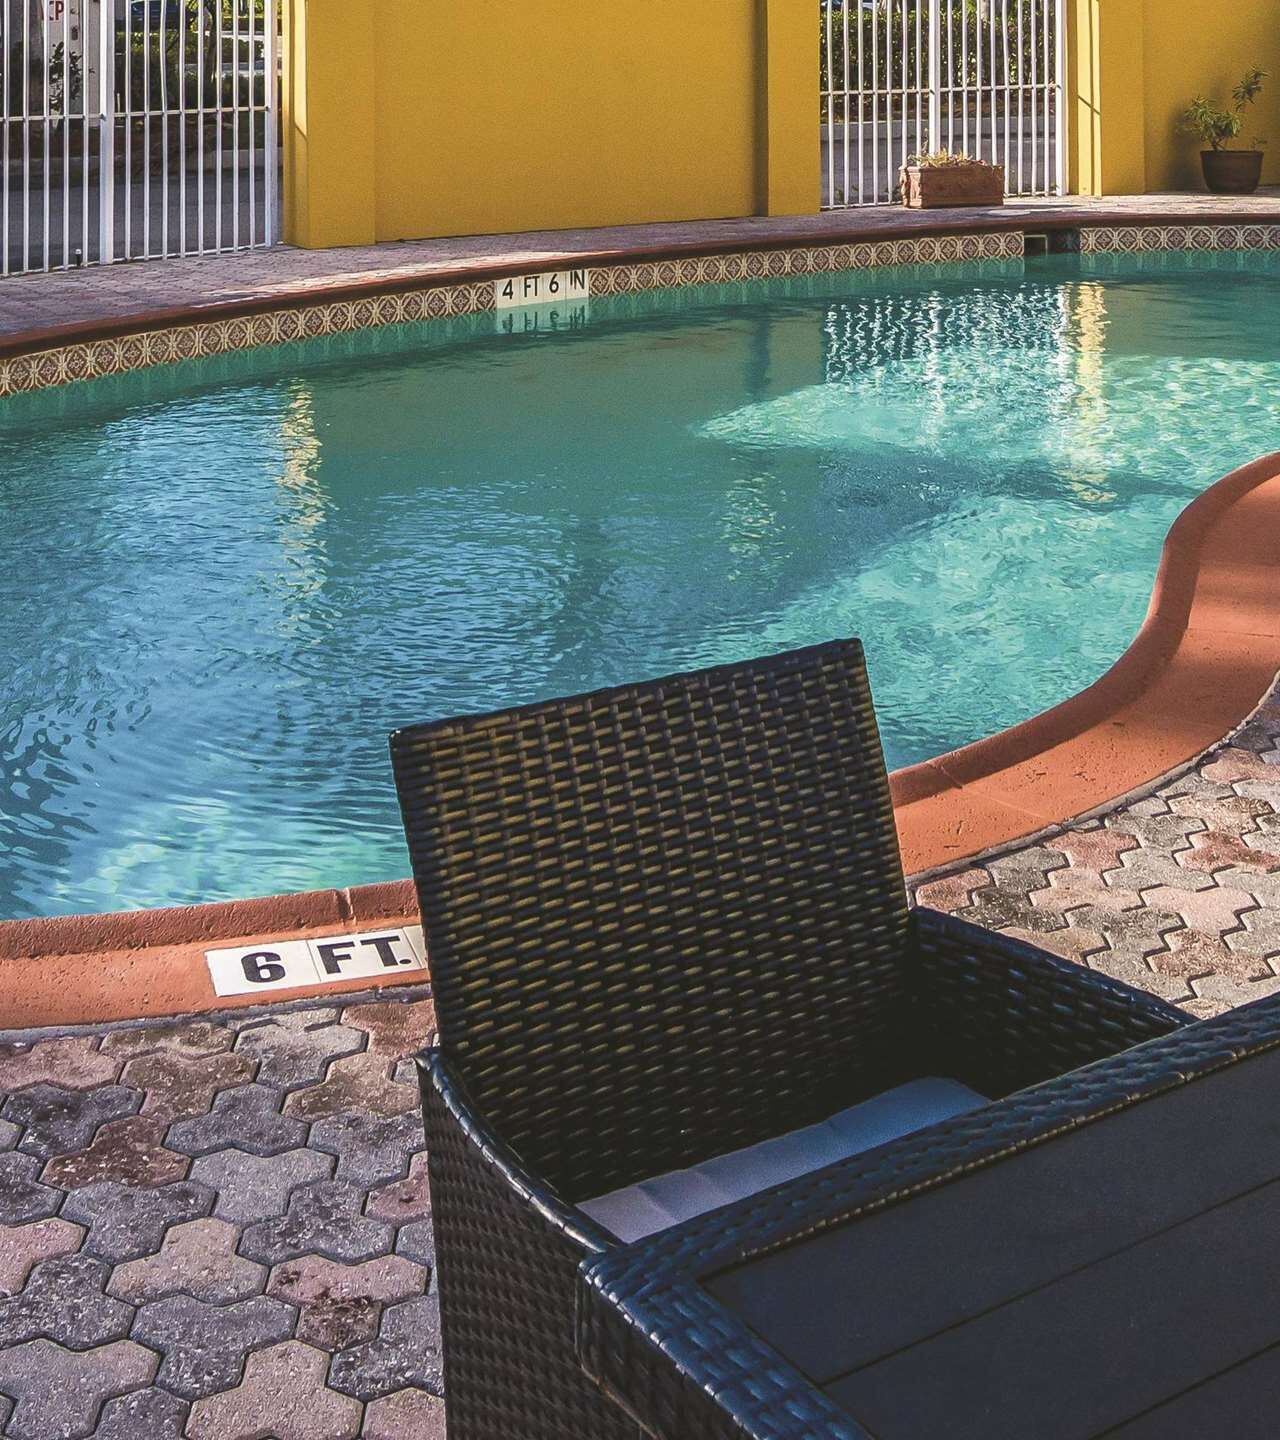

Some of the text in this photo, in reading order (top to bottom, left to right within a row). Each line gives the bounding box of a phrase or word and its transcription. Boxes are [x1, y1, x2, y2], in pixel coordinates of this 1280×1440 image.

[502, 270, 585, 300] 4 FT 6 IN
[241, 935, 412, 983] 6 FT.
